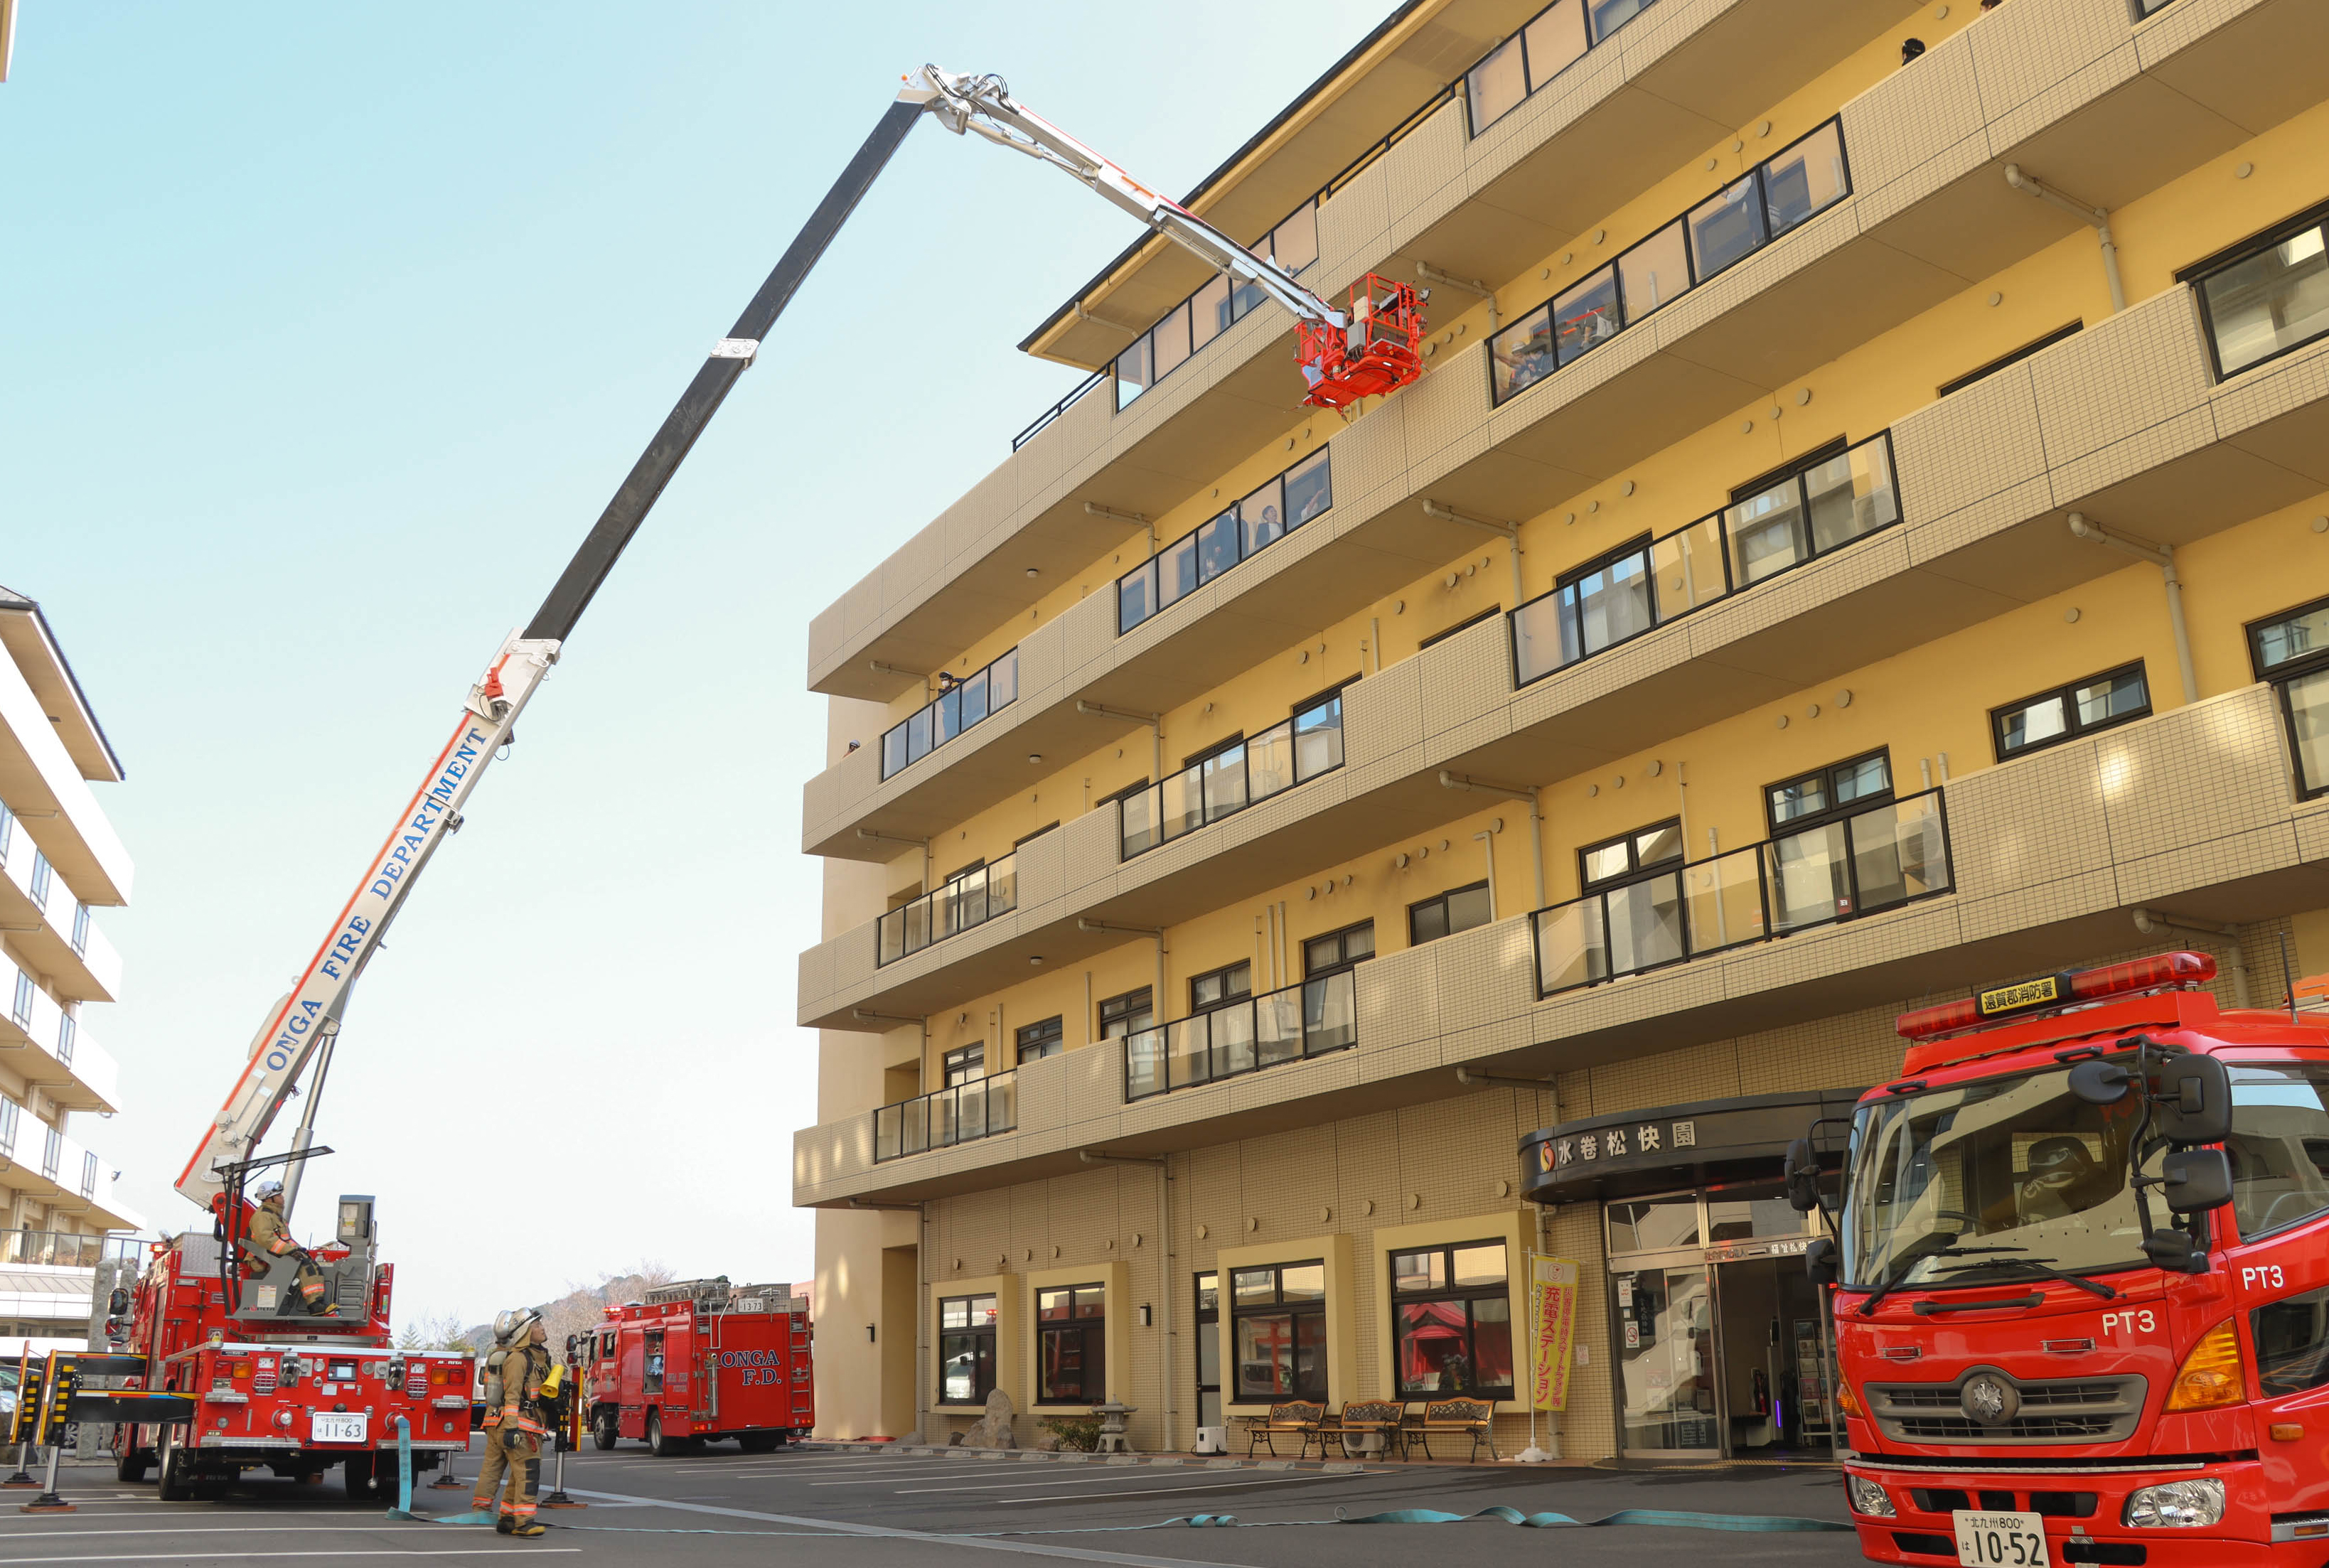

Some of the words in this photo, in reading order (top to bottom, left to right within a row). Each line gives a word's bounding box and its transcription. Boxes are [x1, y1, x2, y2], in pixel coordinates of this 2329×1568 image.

[267, 999, 323, 1072] ONGA
[320, 915, 372, 981] FIRE
[370, 726, 487, 901] DEPARTMENT
[1984, 980, 2054, 1011] 遠賀郡消防署
[1771, 1240, 1816, 1255] 福祉松快
[2242, 1264, 2284, 1290] PT3
[2102, 1309, 2156, 1336] PT3
[1536, 1285, 1561, 1405] 充電ステーション
[720, 1349, 781, 1368] ONGA
[742, 1368, 782, 1386] F.D.
[326, 1423, 361, 1438] 11-63
[1970, 1516, 2021, 1530] 北九州800
[1961, 1540, 1971, 1551] は
[1974, 1530, 2045, 1567] 10-52
